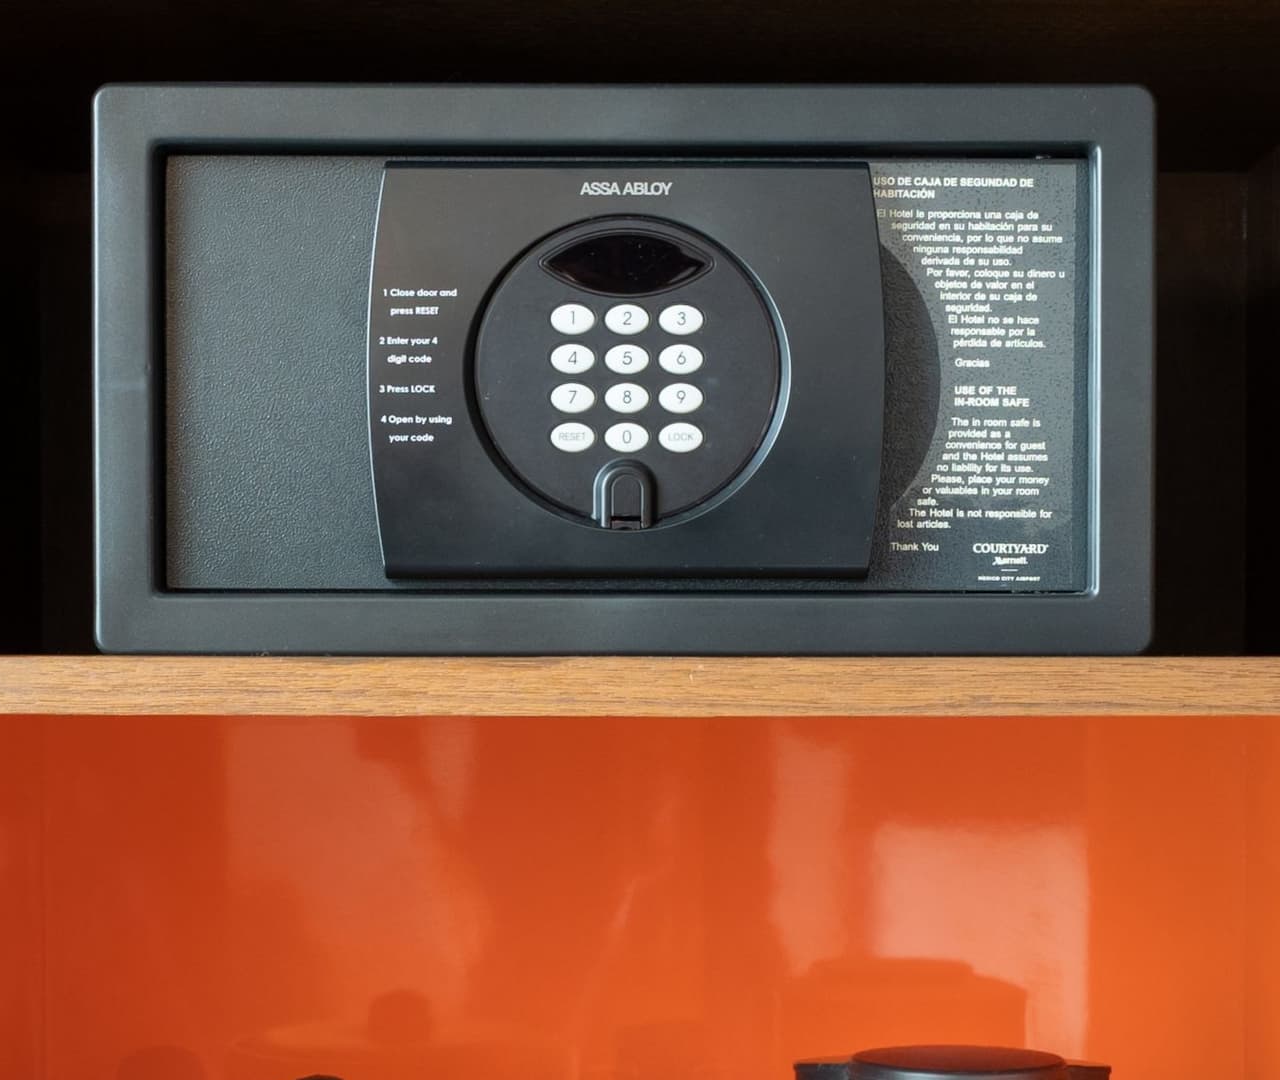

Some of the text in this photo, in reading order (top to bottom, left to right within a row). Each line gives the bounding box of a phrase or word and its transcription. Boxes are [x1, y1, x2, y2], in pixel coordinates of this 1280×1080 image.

[874, 176, 896, 185] USO
[898, 177, 912, 186] DE
[914, 177, 942, 186] CAJA
[943, 178, 957, 186] DE
[1020, 178, 1034, 187] DE
[580, 182, 672, 195] ASSA ABLOY
[890, 209, 913, 218] Hotel
[916, 210, 924, 218] le
[928, 210, 981, 220] proporciona
[984, 211, 1002, 219] una
[1005, 210, 1024, 221] caja
[1027, 211, 1039, 219] de
[892, 221, 936, 231] seguridad
[1017, 223, 1038, 233] para
[1041, 223, 1052, 231] su
[967, 235, 982, 244] por
[985, 233, 994, 242] lo
[997, 235, 1014, 244] que
[1017, 235, 1029, 243] no
[1032, 235, 1063, 243] asume
[913, 245, 1023, 256] ninguna responsabilidad
[921, 256, 1011, 266] derivada de su uso.
[927, 268, 943, 277] Por
[946, 268, 970, 278] favor,
[974, 269, 1010, 279] coloque
[1013, 269, 1024, 278] su
[1027, 269, 1056, 278] dinero
[935, 280, 968, 290] objetos
[971, 280, 983, 289] de
[985, 280, 1008, 289] valor
[1026, 281, 1034, 289] el
[940, 291, 972, 300] interior
[974, 292, 986, 300] de
[1003, 292, 1022, 303] caja
[1025, 292, 1037, 301] de
[390, 307, 438, 316] press RESET
[945, 303, 992, 314] seguridad.
[571, 311, 575, 325] 1
[623, 311, 632, 325] 2
[677, 311, 686, 325] 3
[948, 314, 958, 324] El
[961, 315, 984, 324] Hotel
[1017, 316, 1039, 324] hace
[951, 327, 1035, 337] responsable por la
[411, 338, 430, 346] your
[990, 338, 1002, 347] de
[387, 355, 432, 364] digit code
[568, 352, 576, 365] 4
[623, 352, 632, 365] 5
[677, 352, 686, 365] 6
[955, 358, 990, 367] Gracias
[379, 385, 435, 393] 3 Press LOCK
[955, 386, 1016, 395] USE OF THE
[569, 391, 576, 404] 7
[623, 391, 631, 404] 8
[677, 391, 685, 404] 9
[954, 397, 1029, 407] IN-ROOM SAFE
[381, 415, 452, 425] 4 Open by using
[951, 417, 1041, 427] The in room safe is
[389, 433, 434, 443] your code
[559, 432, 586, 441] RESET
[623, 431, 631, 444] 0
[668, 432, 694, 441] LOCK
[948, 429, 987, 439] provided
[945, 440, 1046, 452] convenience for guest
[942, 452, 960, 460] and
[963, 452, 977, 460] the
[981, 452, 1004, 461] Hotel
[952, 463, 982, 474] liability
[985, 463, 998, 472] for
[1001, 464, 1011, 472] its
[931, 474, 1049, 486] Please, place your money
[923, 486, 1039, 496] or valuables in your room
[917, 497, 939, 506] safe.
[909, 508, 1052, 520] The Hotel is not responsible for
[897, 520, 951, 528] lost articles.
[891, 542, 939, 551] Thank You
